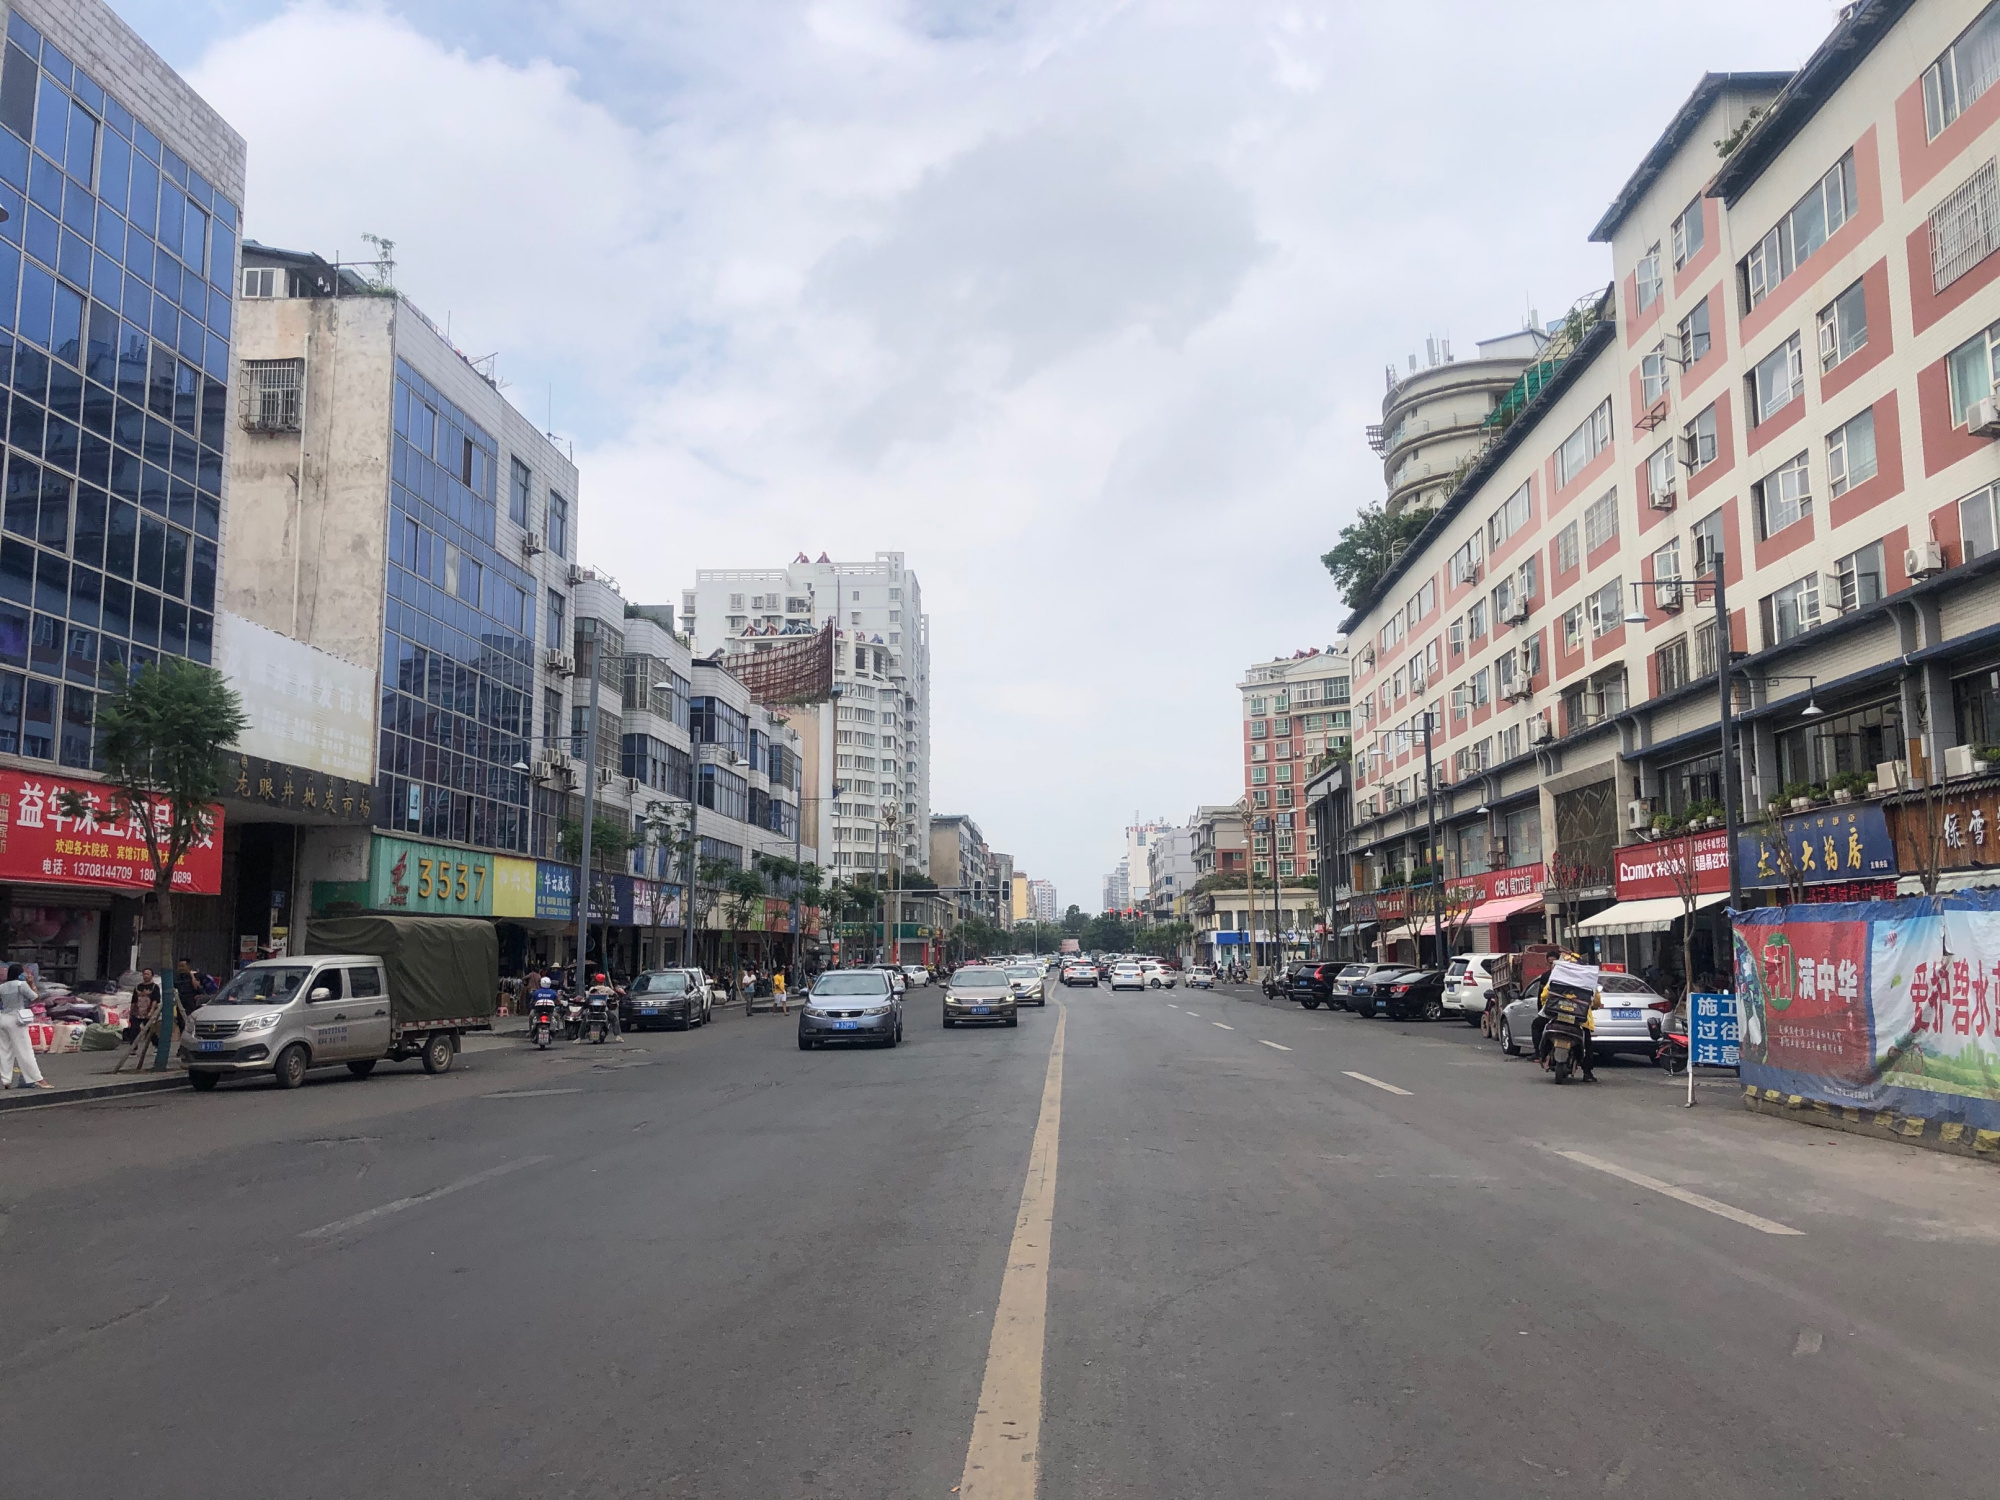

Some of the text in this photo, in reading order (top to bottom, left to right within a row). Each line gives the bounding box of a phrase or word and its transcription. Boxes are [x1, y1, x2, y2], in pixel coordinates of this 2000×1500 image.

[16, 780, 214, 850] 益华床上用品发
[234, 769, 372, 820] 龙眼井批发市场
[1944, 805, 2000, 849] 绿雪
[73, 861, 132, 880] 13708144709
[140, 867, 192, 884] 1800889
[418, 857, 487, 902] 3537
[1692, 851, 1730, 872] 西昌易召文
[1494, 878, 1510, 898] deli
